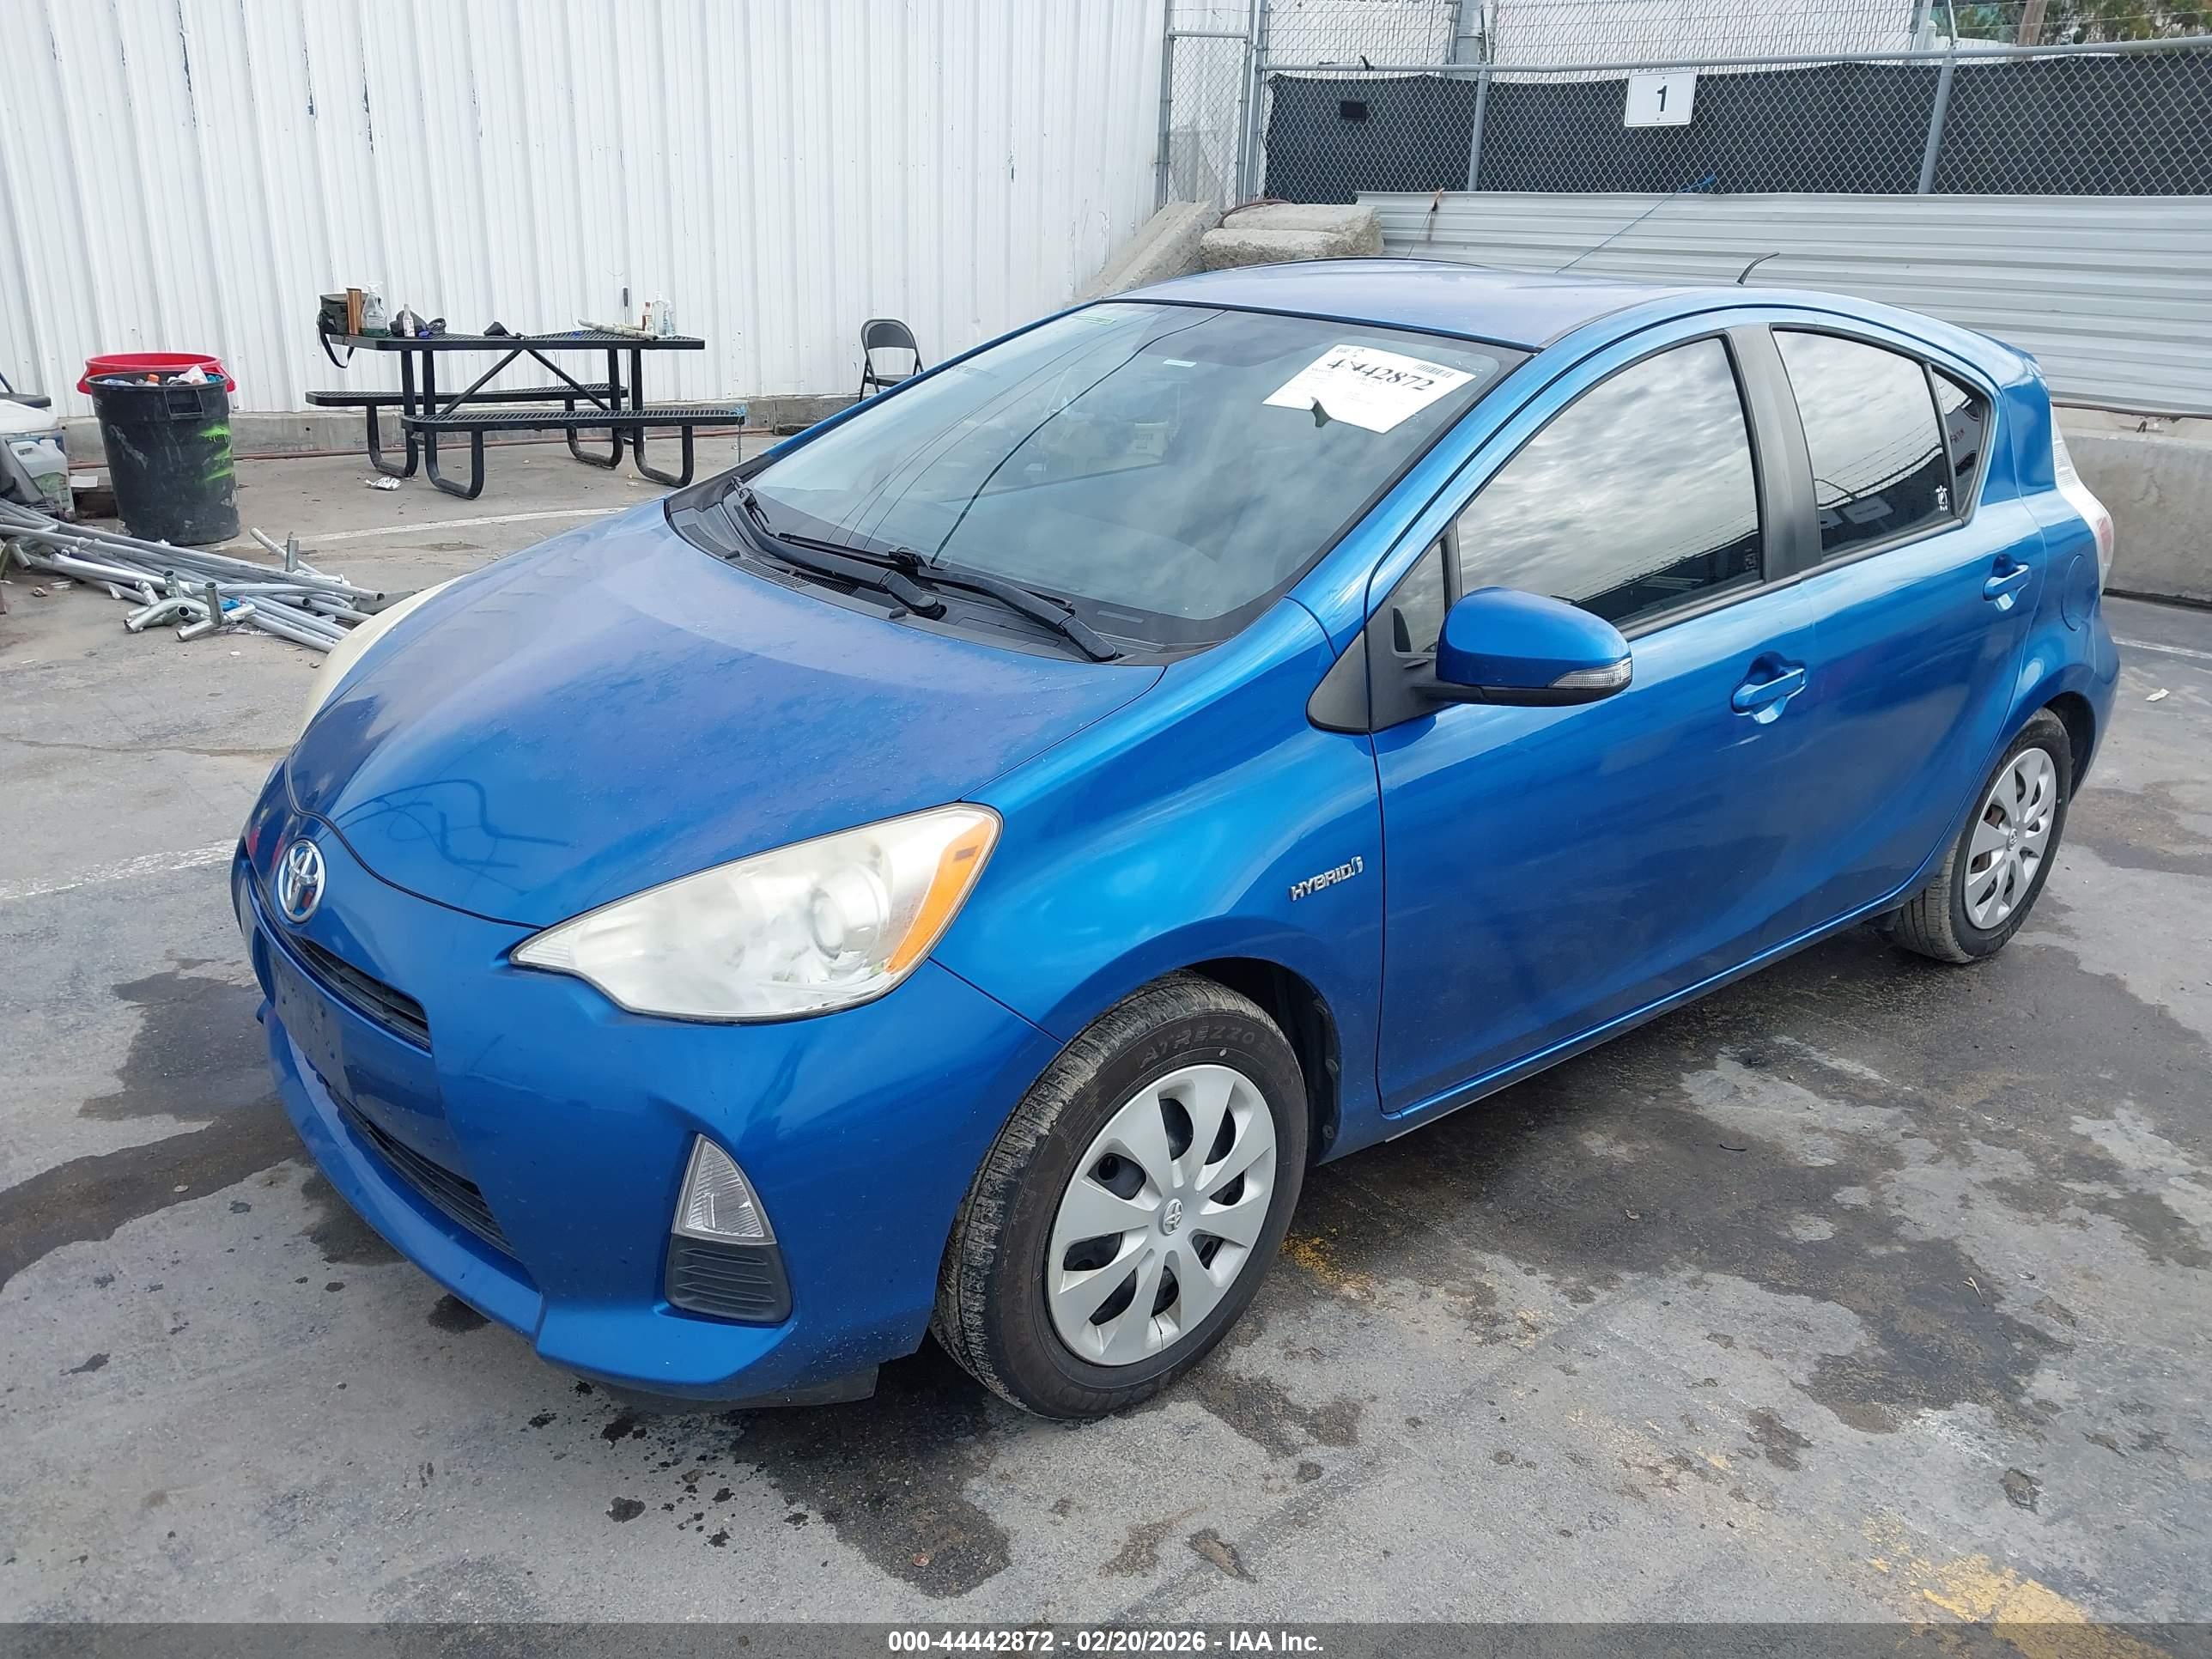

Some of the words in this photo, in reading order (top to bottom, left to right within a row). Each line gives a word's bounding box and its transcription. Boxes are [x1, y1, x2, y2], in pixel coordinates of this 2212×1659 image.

[1656, 84, 1668, 112] 1
[1327, 358, 1434, 391] 4442872
[1291, 863, 1352, 901] HYBRID
